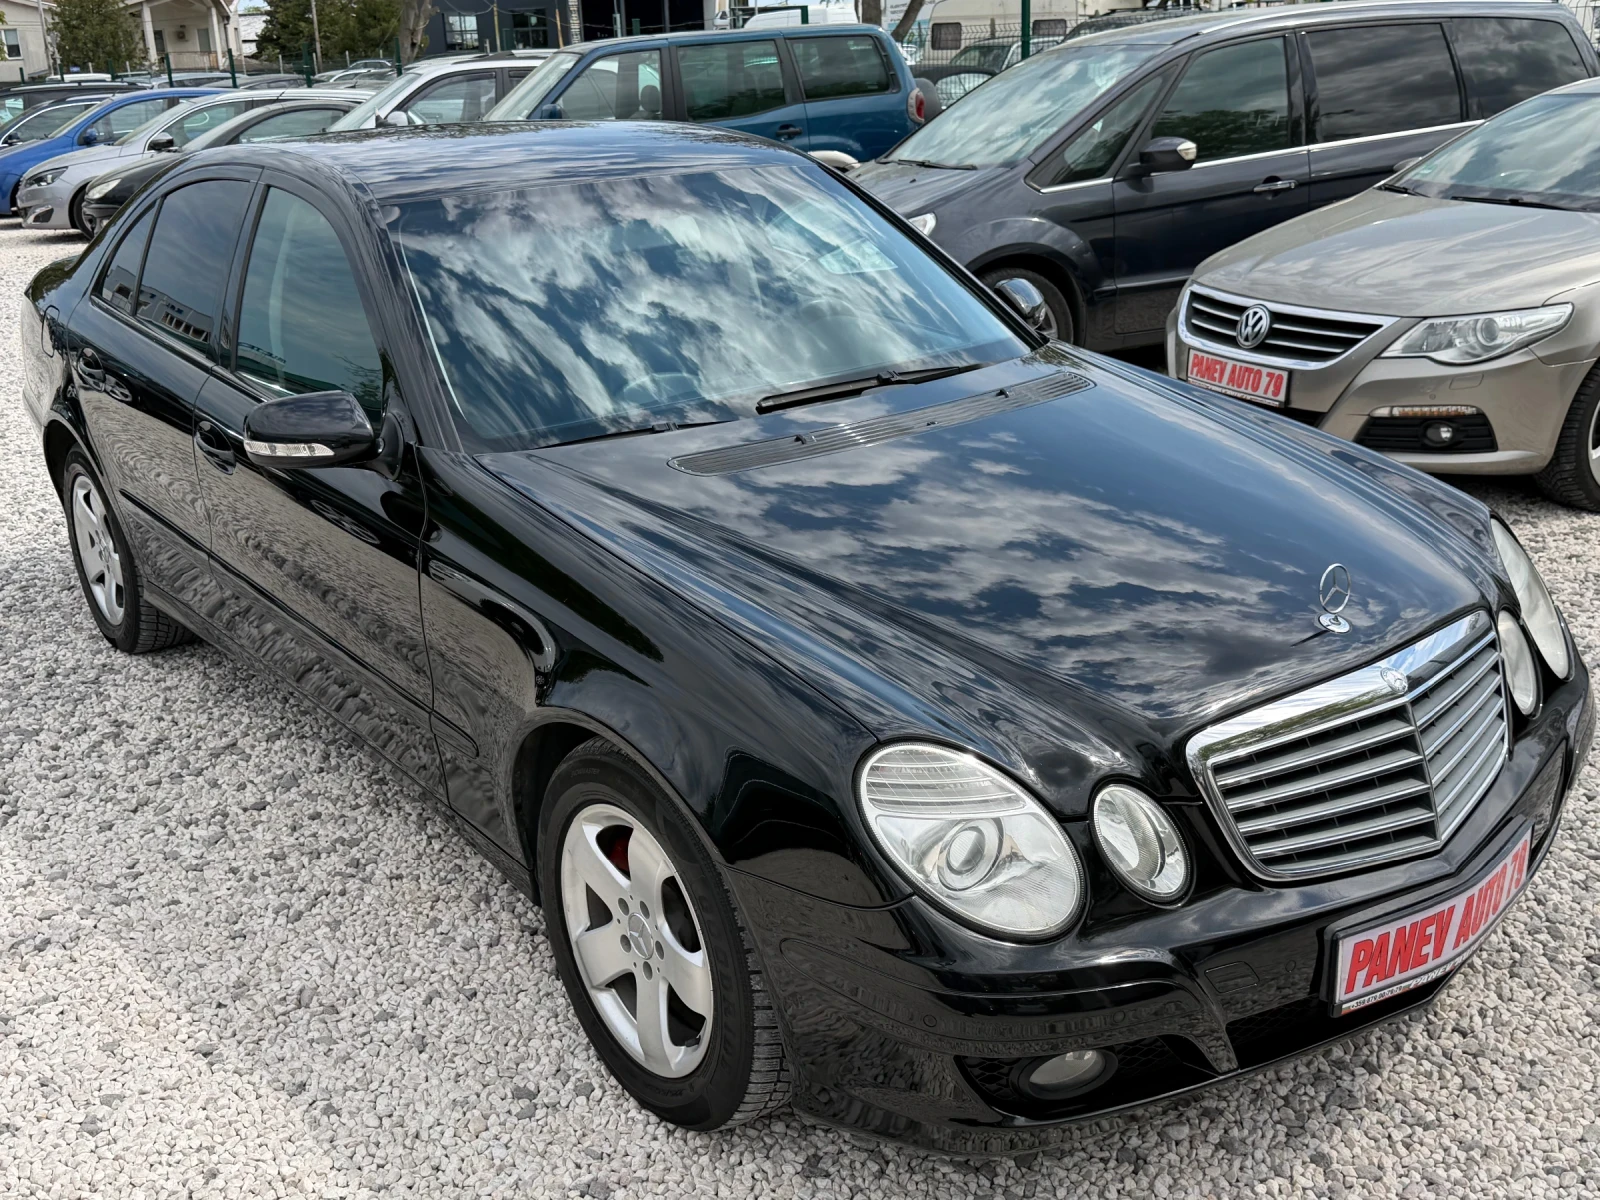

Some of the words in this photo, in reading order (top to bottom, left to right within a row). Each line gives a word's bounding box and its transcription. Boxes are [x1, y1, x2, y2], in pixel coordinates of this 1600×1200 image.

[1190, 353, 1228, 384] PANEV
[1227, 363, 1263, 392] AUTO
[1262, 371, 1284, 398] 79
[1344, 904, 1456, 995] PANEV
[1452, 862, 1508, 951] AUTO
[1506, 839, 1529, 901] 79
